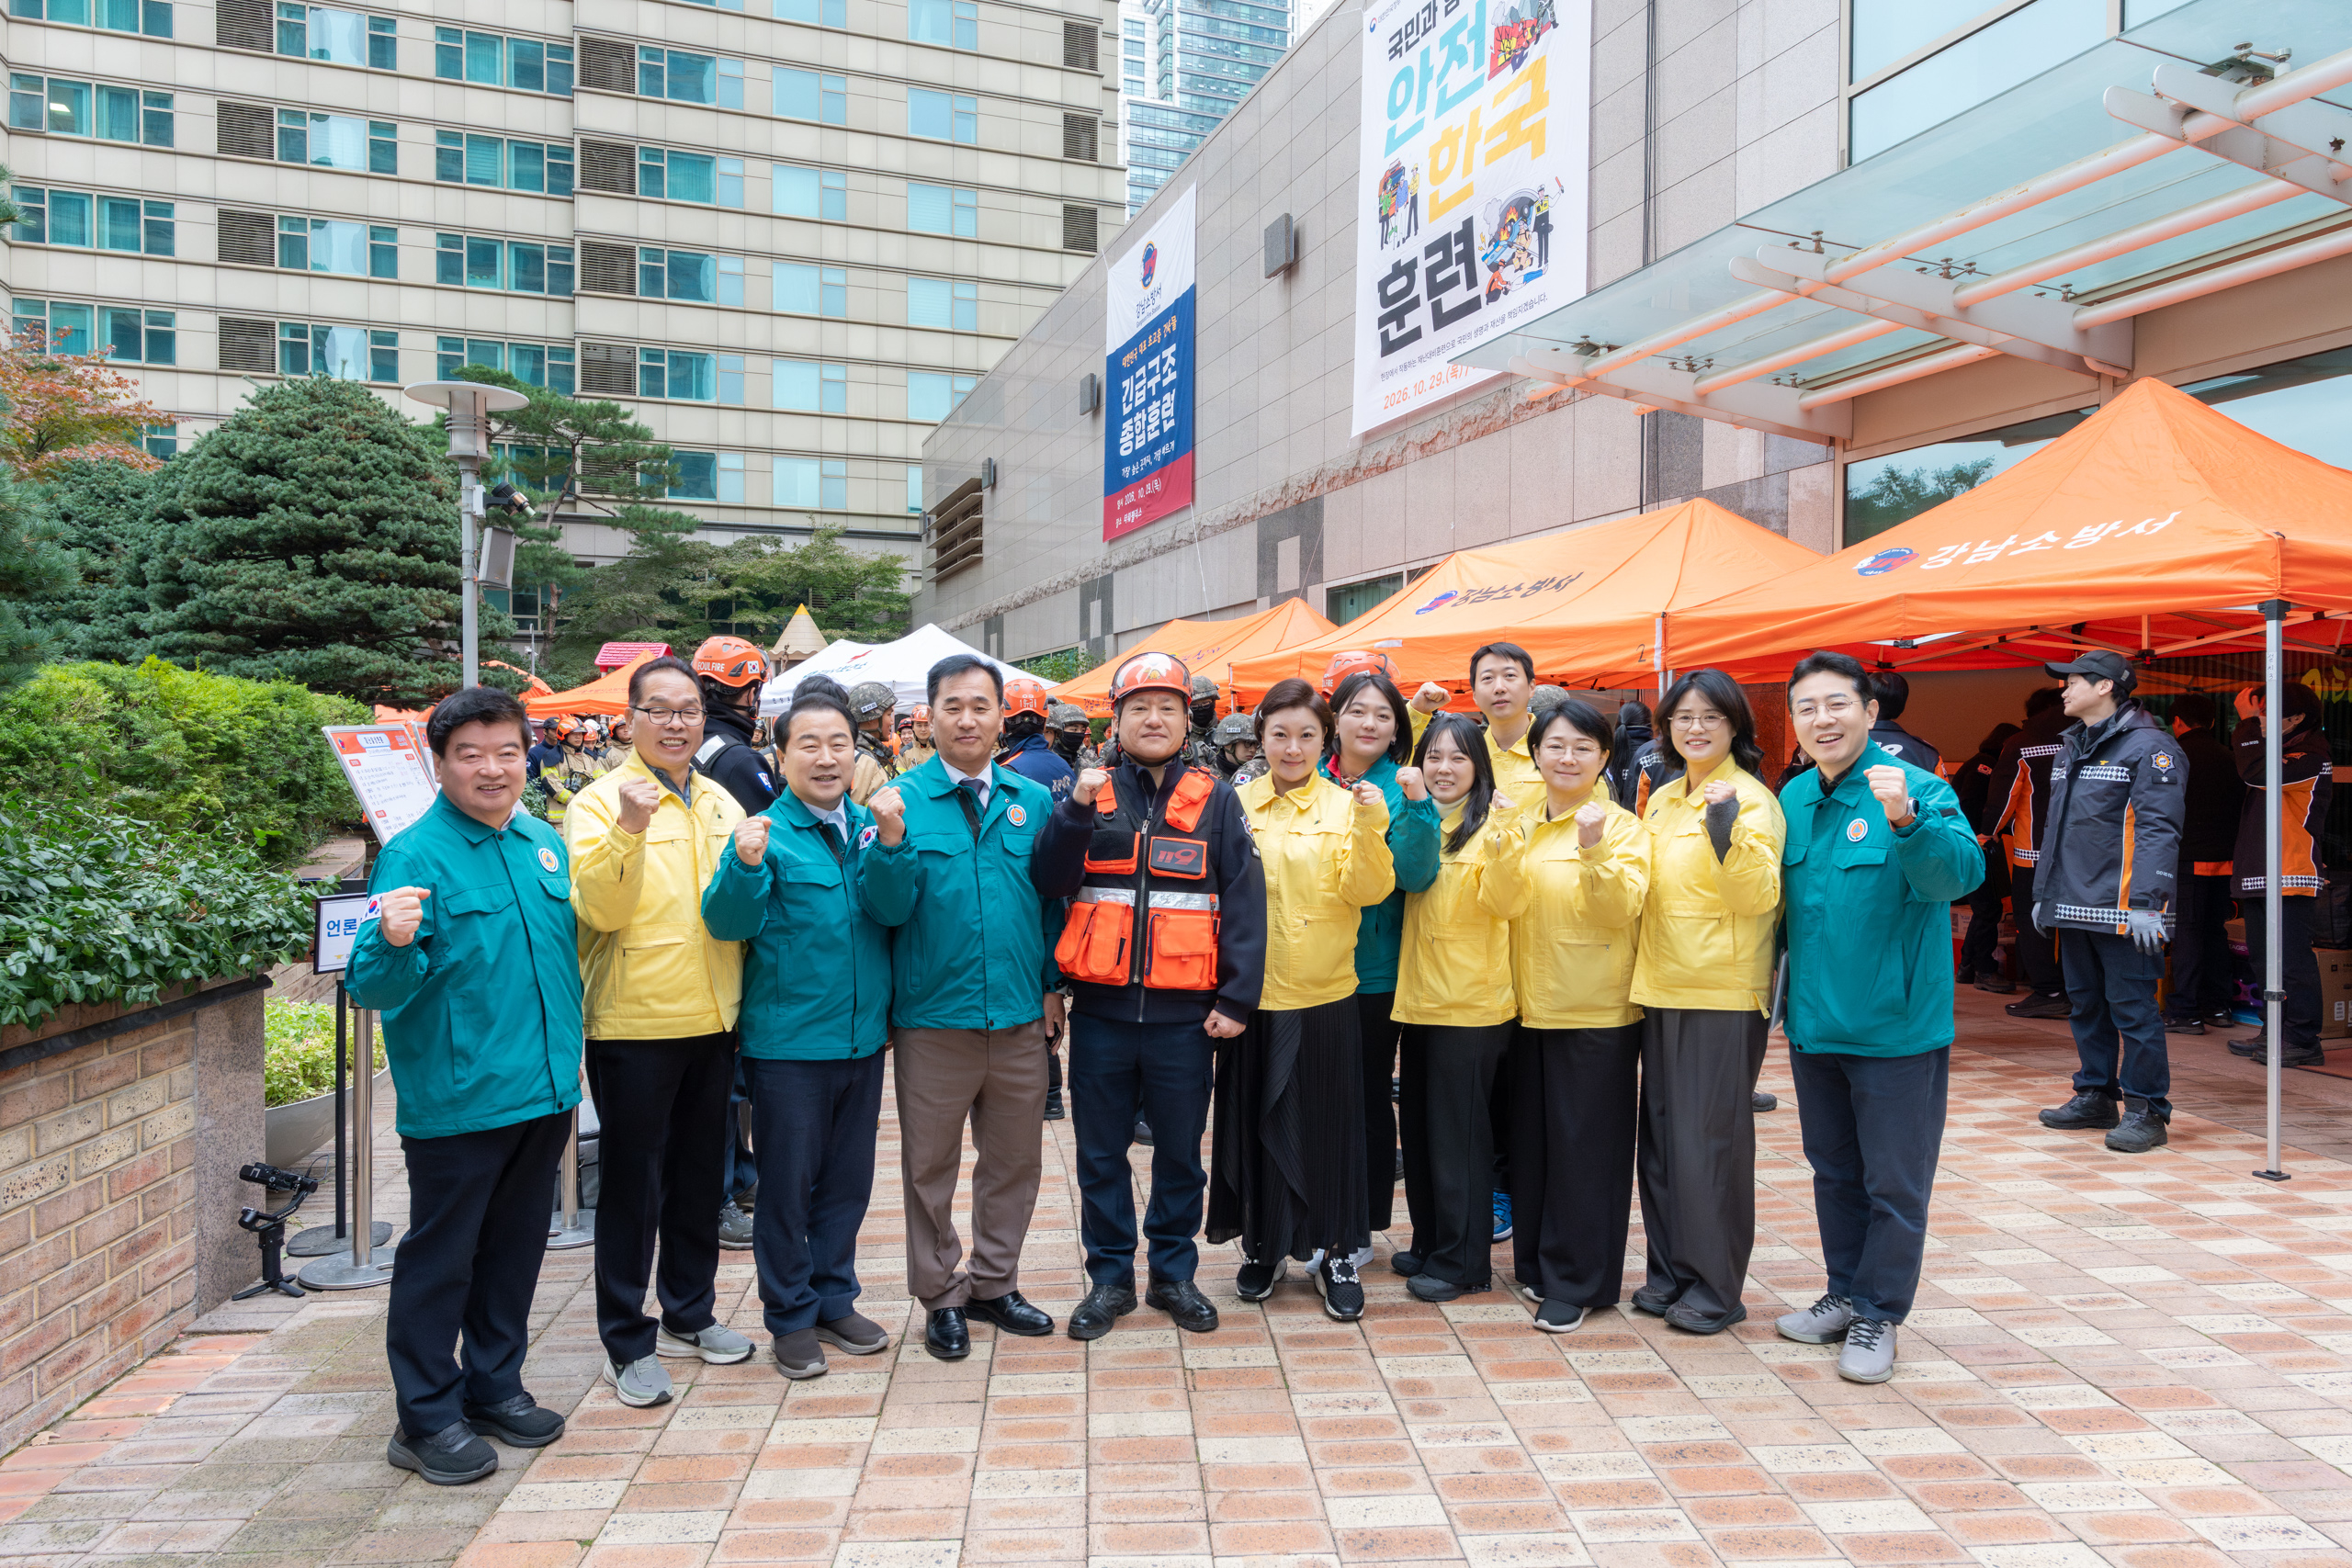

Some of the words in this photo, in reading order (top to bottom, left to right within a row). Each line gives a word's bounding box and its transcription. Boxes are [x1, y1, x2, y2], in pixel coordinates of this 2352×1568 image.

[1388, 0, 1438, 62] 국민과
[1384, 0, 1487, 159] 안전
[1428, 54, 1550, 224] 한국
[1136, 283, 1161, 319] 강남소방서
[1377, 215, 1482, 358] 훈련
[1122, 347, 1137, 367] 대한민국
[1148, 328, 1161, 347] 초고층
[1380, 366, 1398, 382] 현장에서
[1399, 358, 1417, 373] 작동하는
[1457, 331, 1473, 345] 국민의
[1473, 322, 1489, 338] 생명과
[1489, 313, 1507, 329] 재산을
[1122, 343, 1177, 416] 긴급구조
[1384, 387, 1410, 410] 2026.
[1413, 379, 1427, 397] 10.
[1119, 388, 1176, 457] 종합훈련
[1919, 510, 2183, 570] 강남소방서
[1451, 571, 1585, 608] 강남소방서
[697, 661, 710, 671] EOUL
[711, 661, 726, 672] FIRE
[1635, 643, 1646, 662] 2
[1157, 849, 1198, 865] 119
[326, 919, 362, 937] 언론
